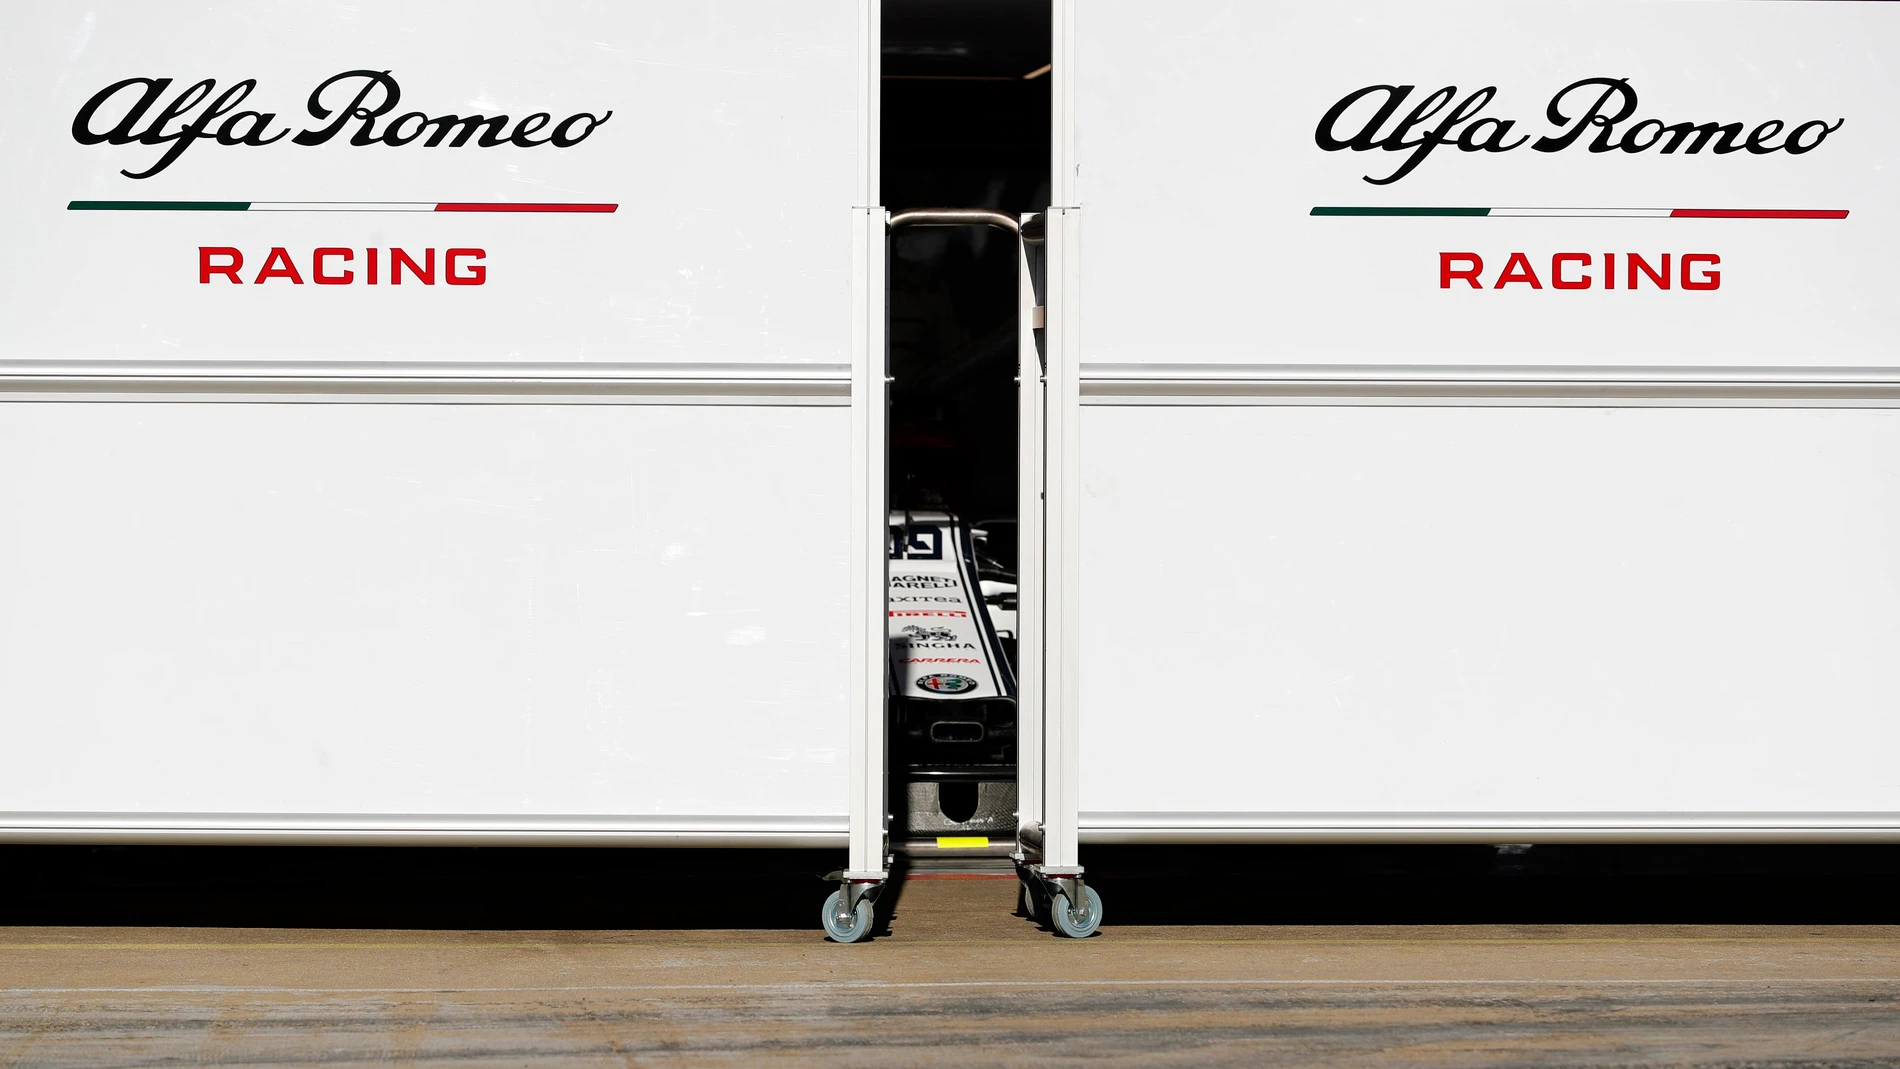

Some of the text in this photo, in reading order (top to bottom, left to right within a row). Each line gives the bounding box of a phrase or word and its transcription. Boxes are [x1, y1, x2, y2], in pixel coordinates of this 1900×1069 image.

[72, 70, 613, 179] Alfa Romeo
[1315, 78, 1844, 185] Alfa Romeo
[199, 247, 486, 285] RACING
[1439, 252, 1720, 290] RACING
[890, 575, 957, 584] AGNETI
[895, 642, 976, 650] SINGHA
[898, 657, 981, 665] CARRERA
